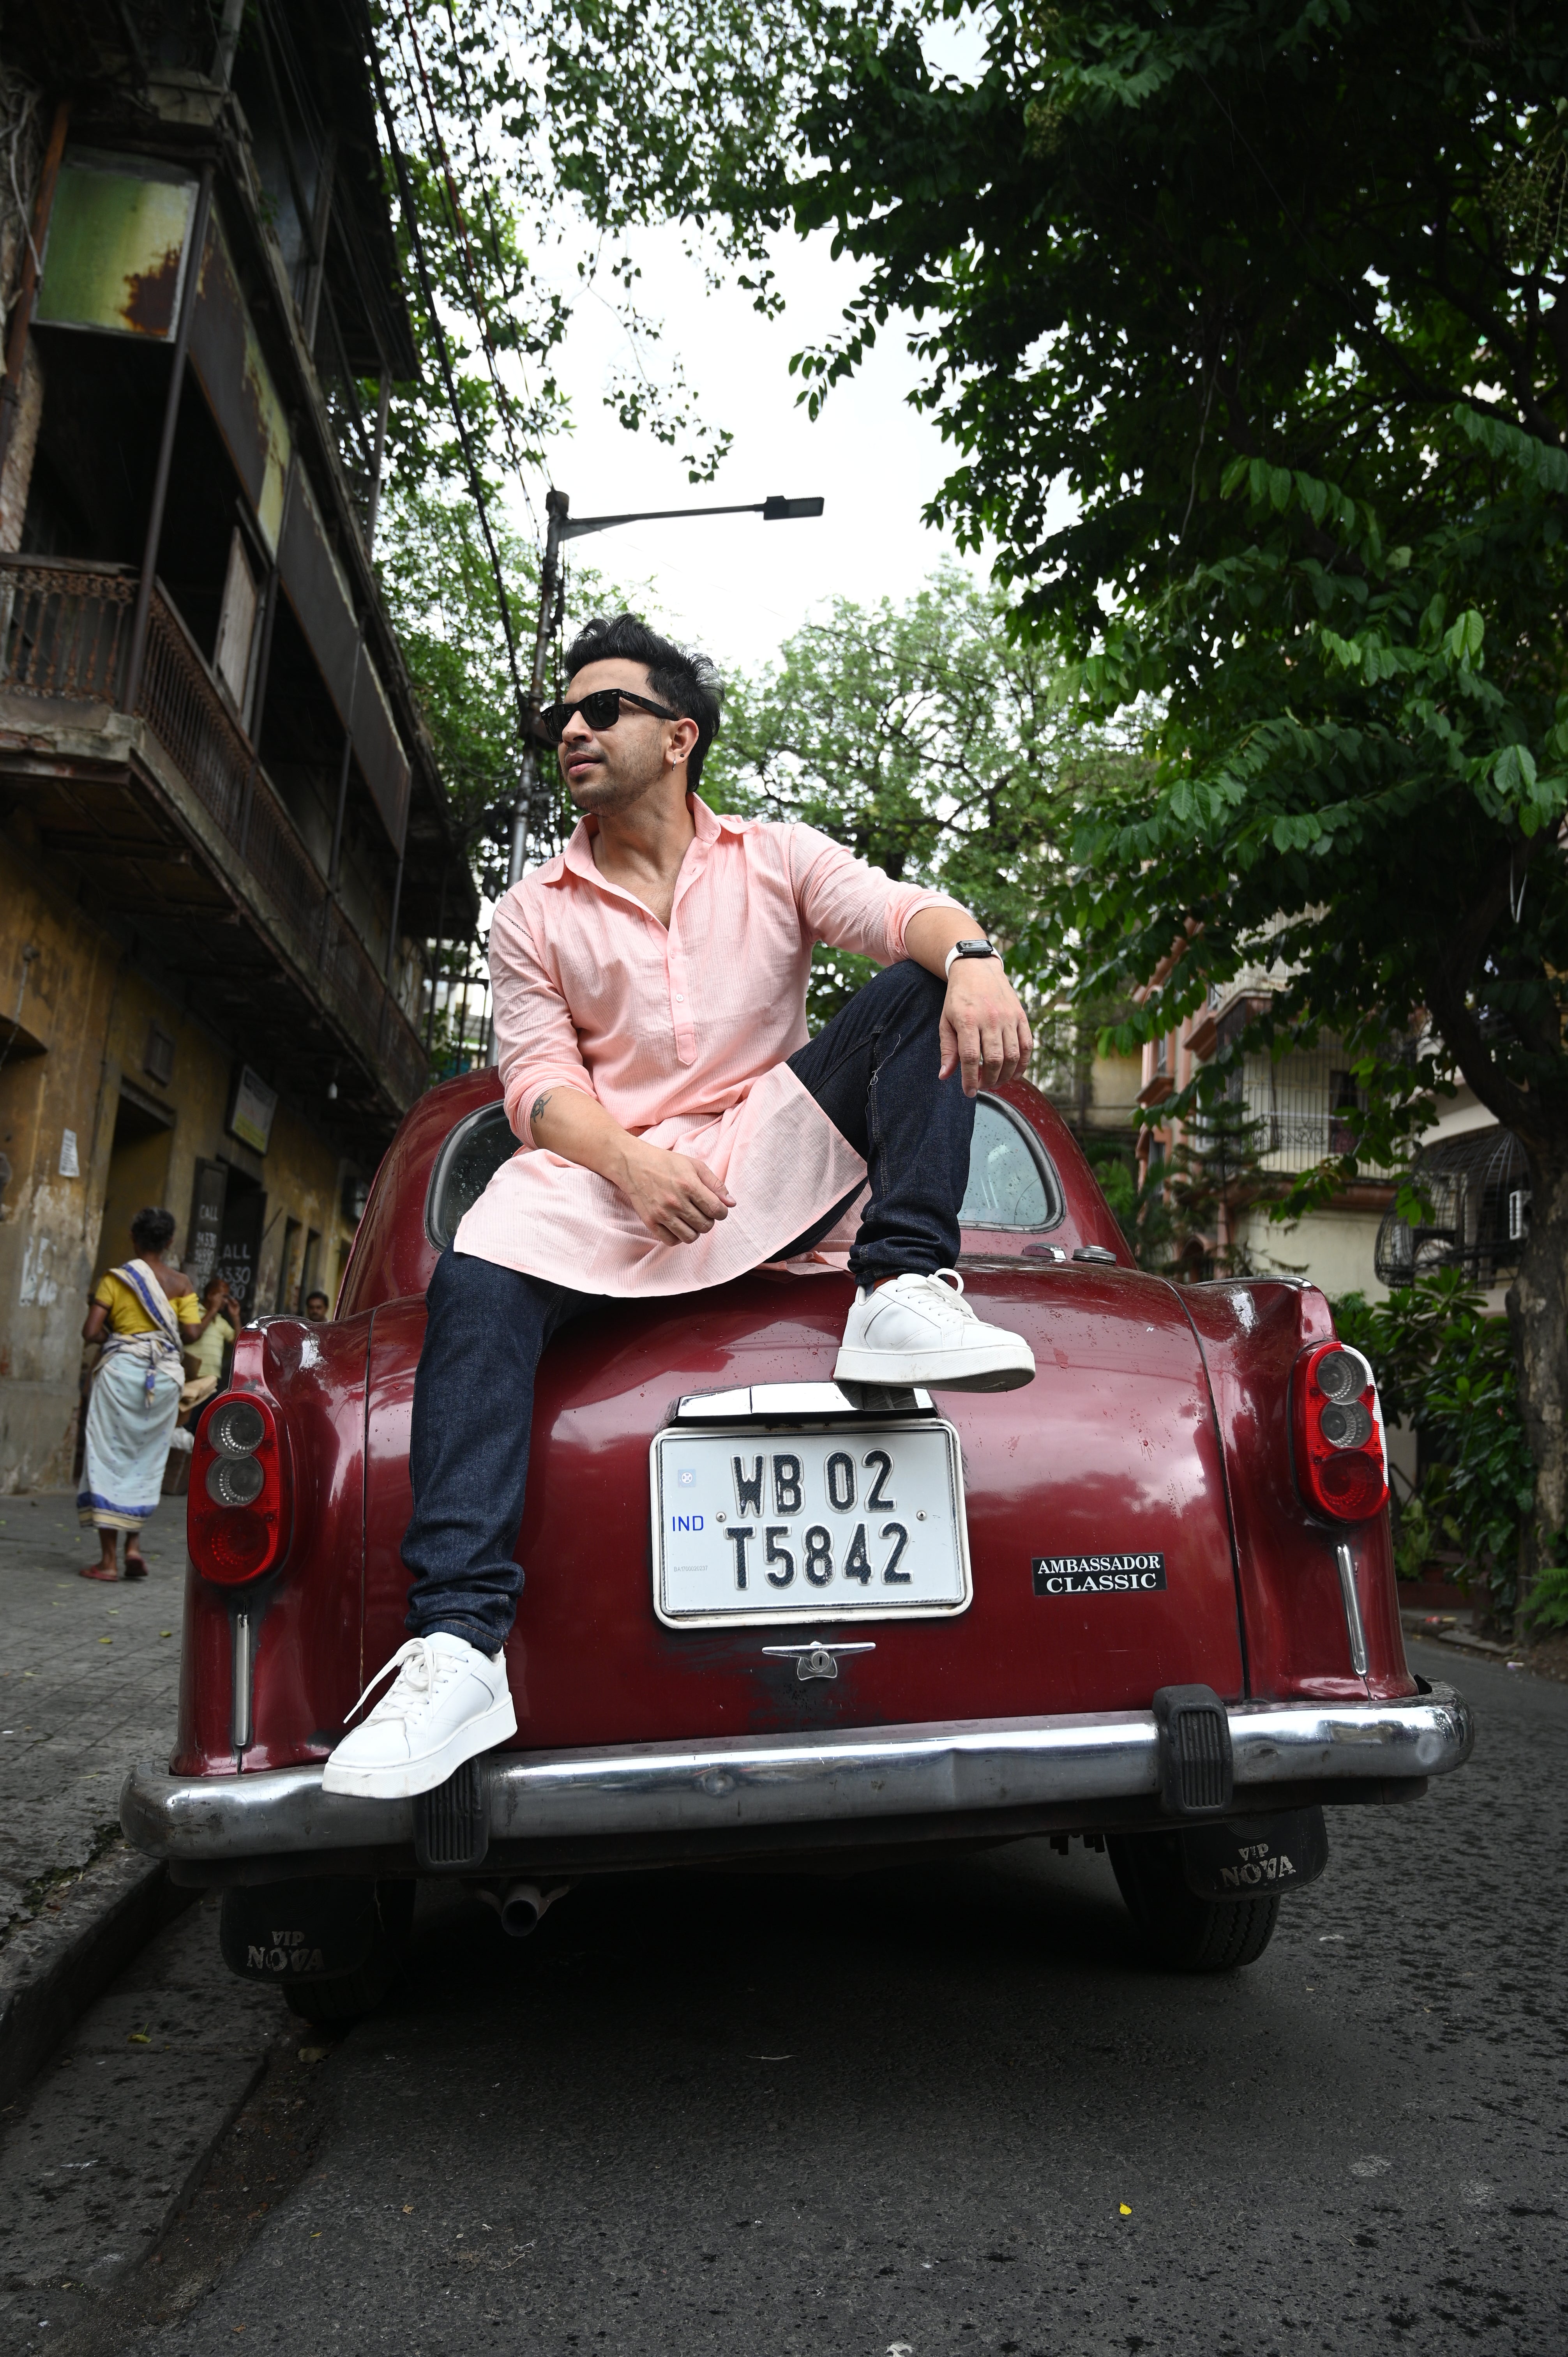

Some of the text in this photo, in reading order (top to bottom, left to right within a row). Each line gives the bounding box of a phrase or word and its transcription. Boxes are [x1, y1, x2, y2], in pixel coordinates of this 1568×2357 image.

[218, 1244, 251, 1259] ALL
[217, 1266, 251, 1285] 4330
[731, 1449, 897, 1518] WB 02
[672, 1515, 704, 1532] IND
[724, 1520, 913, 1590] T5842
[1037, 1555, 1161, 1574] AMBASSADOR
[1046, 1573, 1157, 1593] CLASSIC
[1238, 1843, 1269, 1861] VIP
[1220, 1855, 1296, 1887] NOVA
[272, 1931, 305, 1946] VIP
[247, 1945, 325, 1972] NOVA
